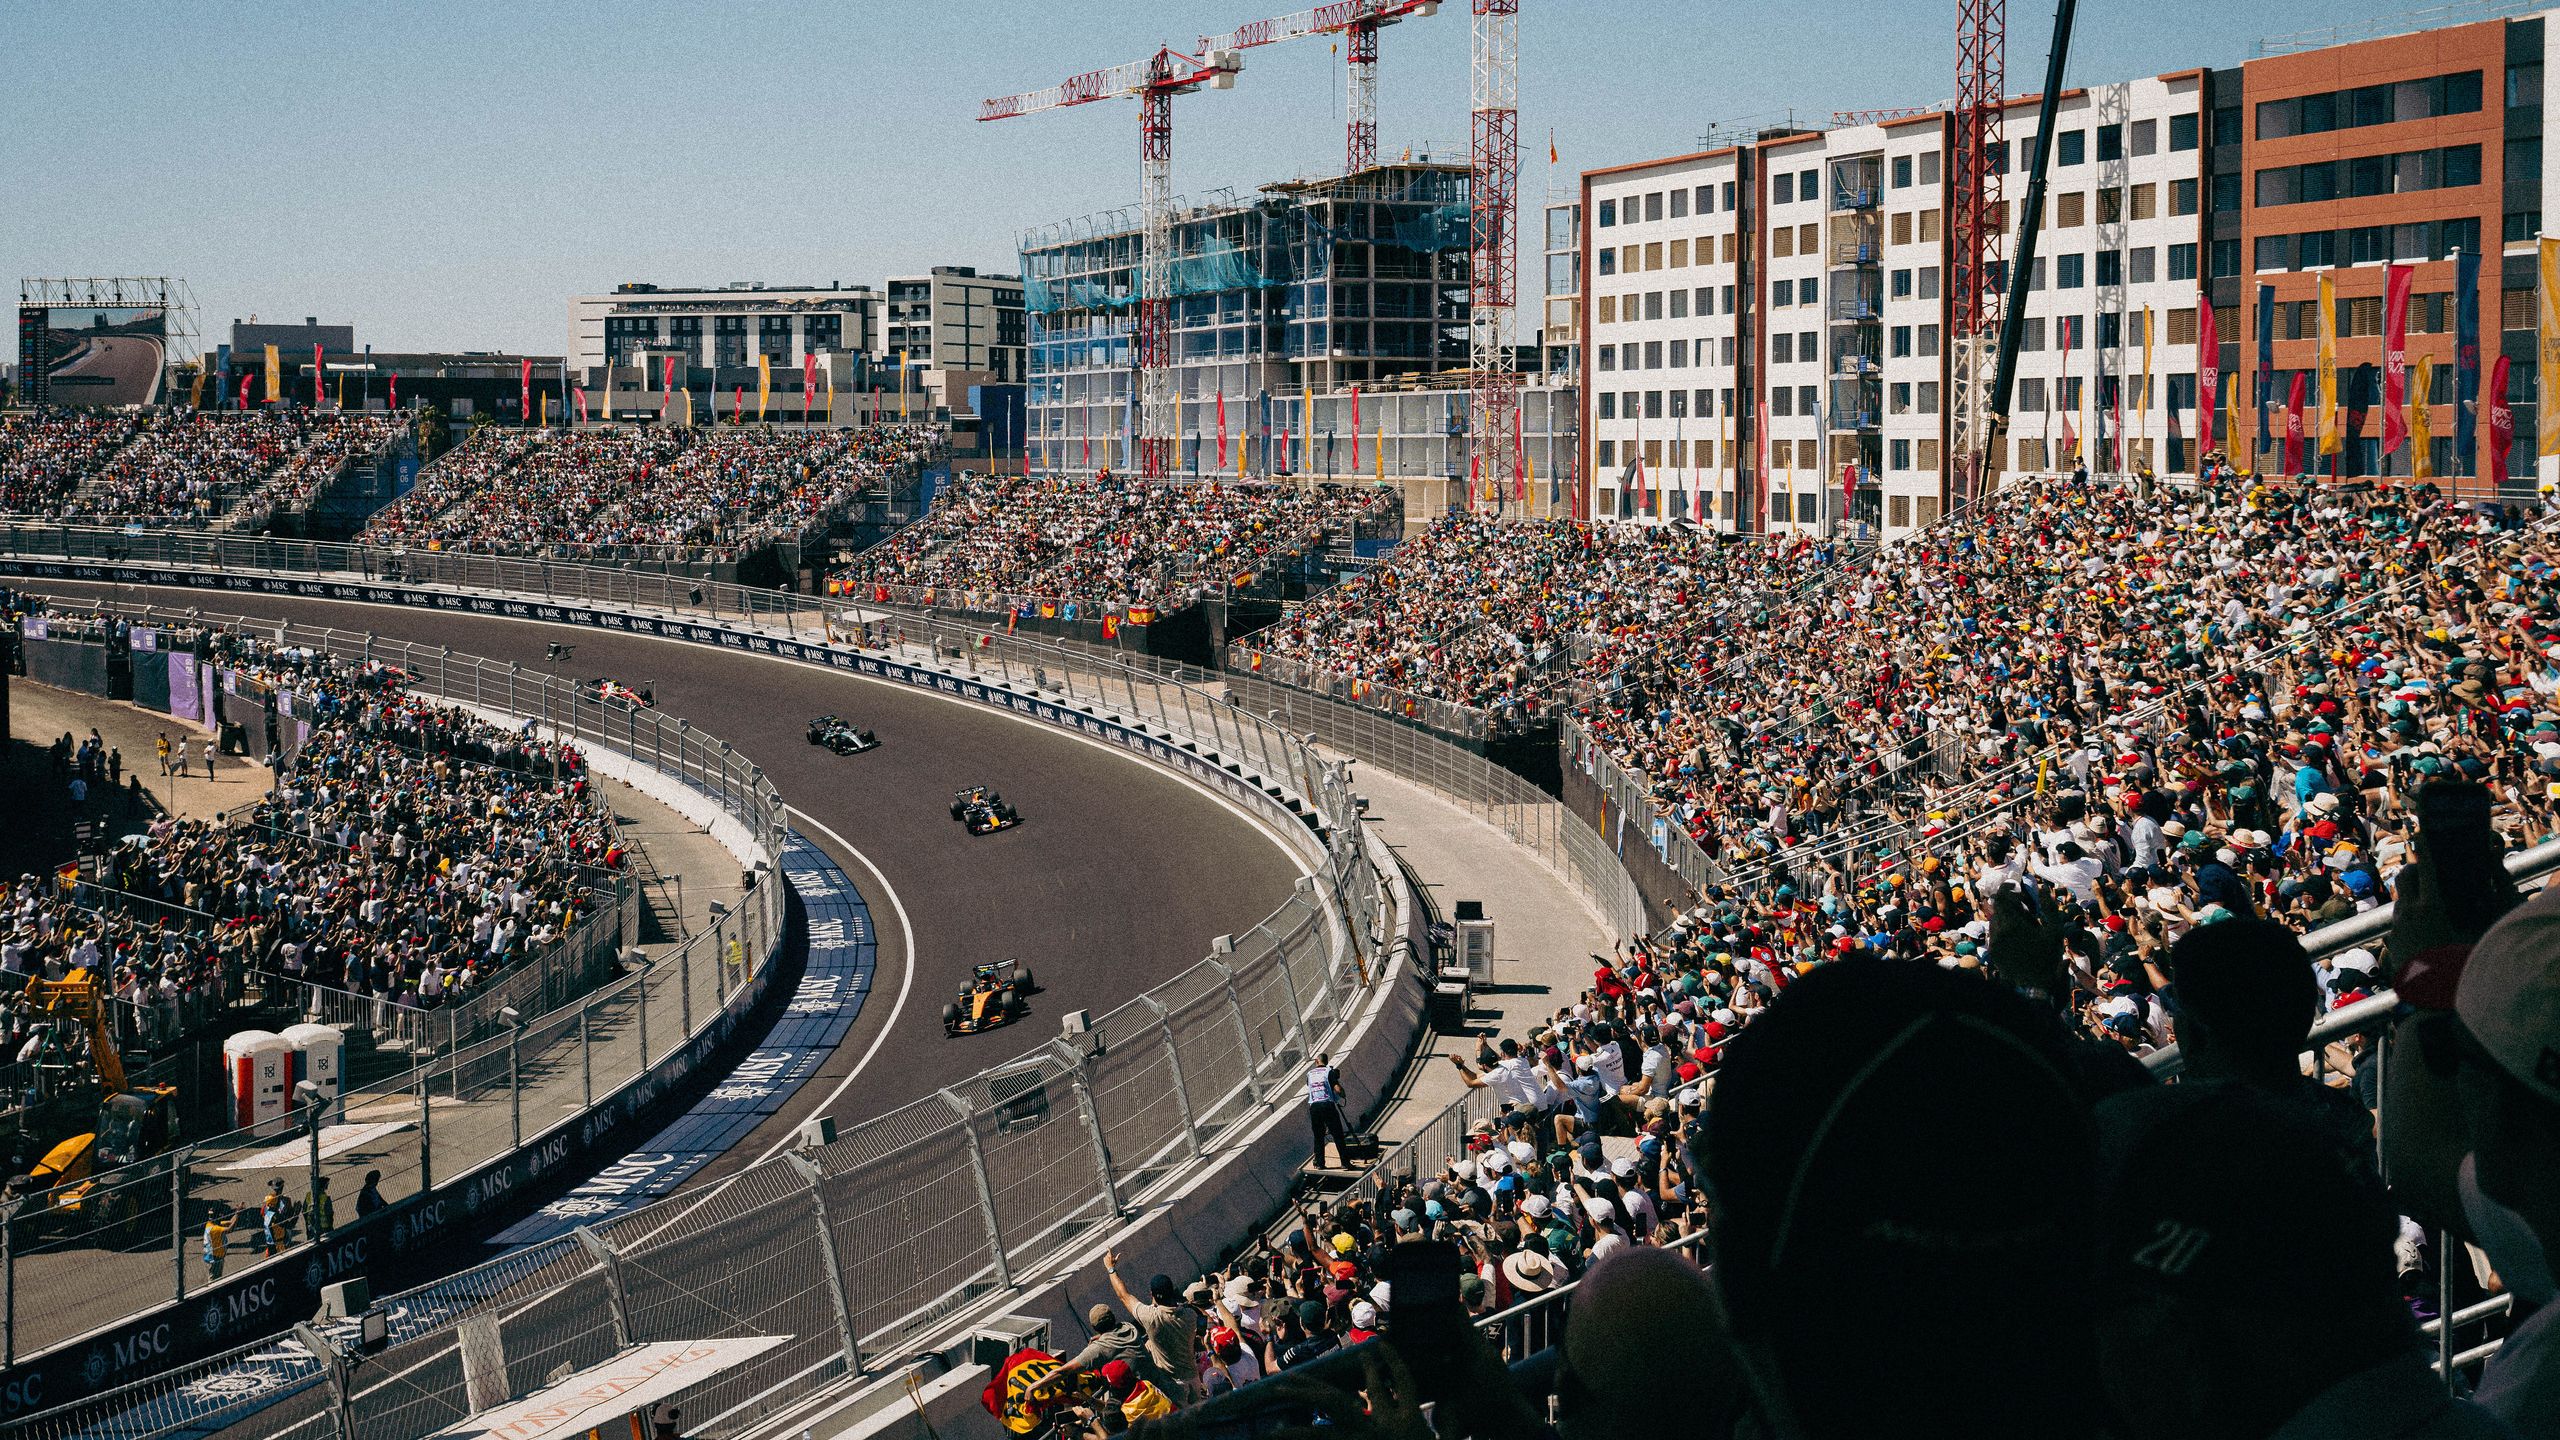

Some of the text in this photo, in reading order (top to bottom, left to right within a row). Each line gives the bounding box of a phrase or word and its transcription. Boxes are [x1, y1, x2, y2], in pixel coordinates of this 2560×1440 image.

[4, 563, 23, 572] MSC
[44, 566, 63, 574] MSC
[82, 568, 101, 576] MSC
[122, 570, 140, 579] MSC
[160, 573, 178, 581] MSC
[197, 576, 215, 584] MSC
[234, 578, 252, 587] MSC
[270, 581, 289, 590] MSC
[306, 584, 324, 593] MSC
[341, 587, 359, 597] MSC
[376, 591, 393, 600] MSC
[411, 594, 428, 603] MSC
[444, 597, 462, 606] MSC
[478, 601, 495, 610] MSC
[511, 604, 528, 614] MSC
[544, 607, 560, 618] MSC
[575, 612, 592, 622] MSC
[607, 615, 624, 626] MSC
[638, 620, 653, 630] MSC
[668, 624, 684, 635] MSC
[698, 629, 713, 640] MSC
[727, 634, 741, 645] MSC
[755, 638, 769, 650] MSC
[782, 643, 798, 655] MSC
[810, 649, 825, 661] MSC
[838, 655, 852, 667] MSC
[864, 660, 878, 672] MSC
[891, 666, 905, 679] MSC
[917, 672, 931, 685] MSC
[942, 678, 956, 691] MSC
[967, 684, 981, 697] MSC
[992, 691, 1006, 705] MSC
[1017, 698, 1030, 712] MSC
[1041, 706, 1054, 720] MSC
[807, 918, 844, 940] MSC
[793, 974, 842, 999] MSC
[672, 1054, 688, 1080] MSC
[723, 1052, 792, 1083] MSC
[637, 1079, 656, 1109] MSC
[594, 1105, 615, 1137] MSC
[542, 1134, 567, 1168] MSC
[569, 1153, 674, 1195] MSC
[481, 1166, 512, 1201] MSC
[410, 1200, 446, 1238] MSC
[2132, 1217, 2210, 1275] 20
[327, 1237, 368, 1277] MSC
[228, 1279, 276, 1322] MSC
[113, 1324, 170, 1371] MSC
[0, 1373, 42, 1413] SC
